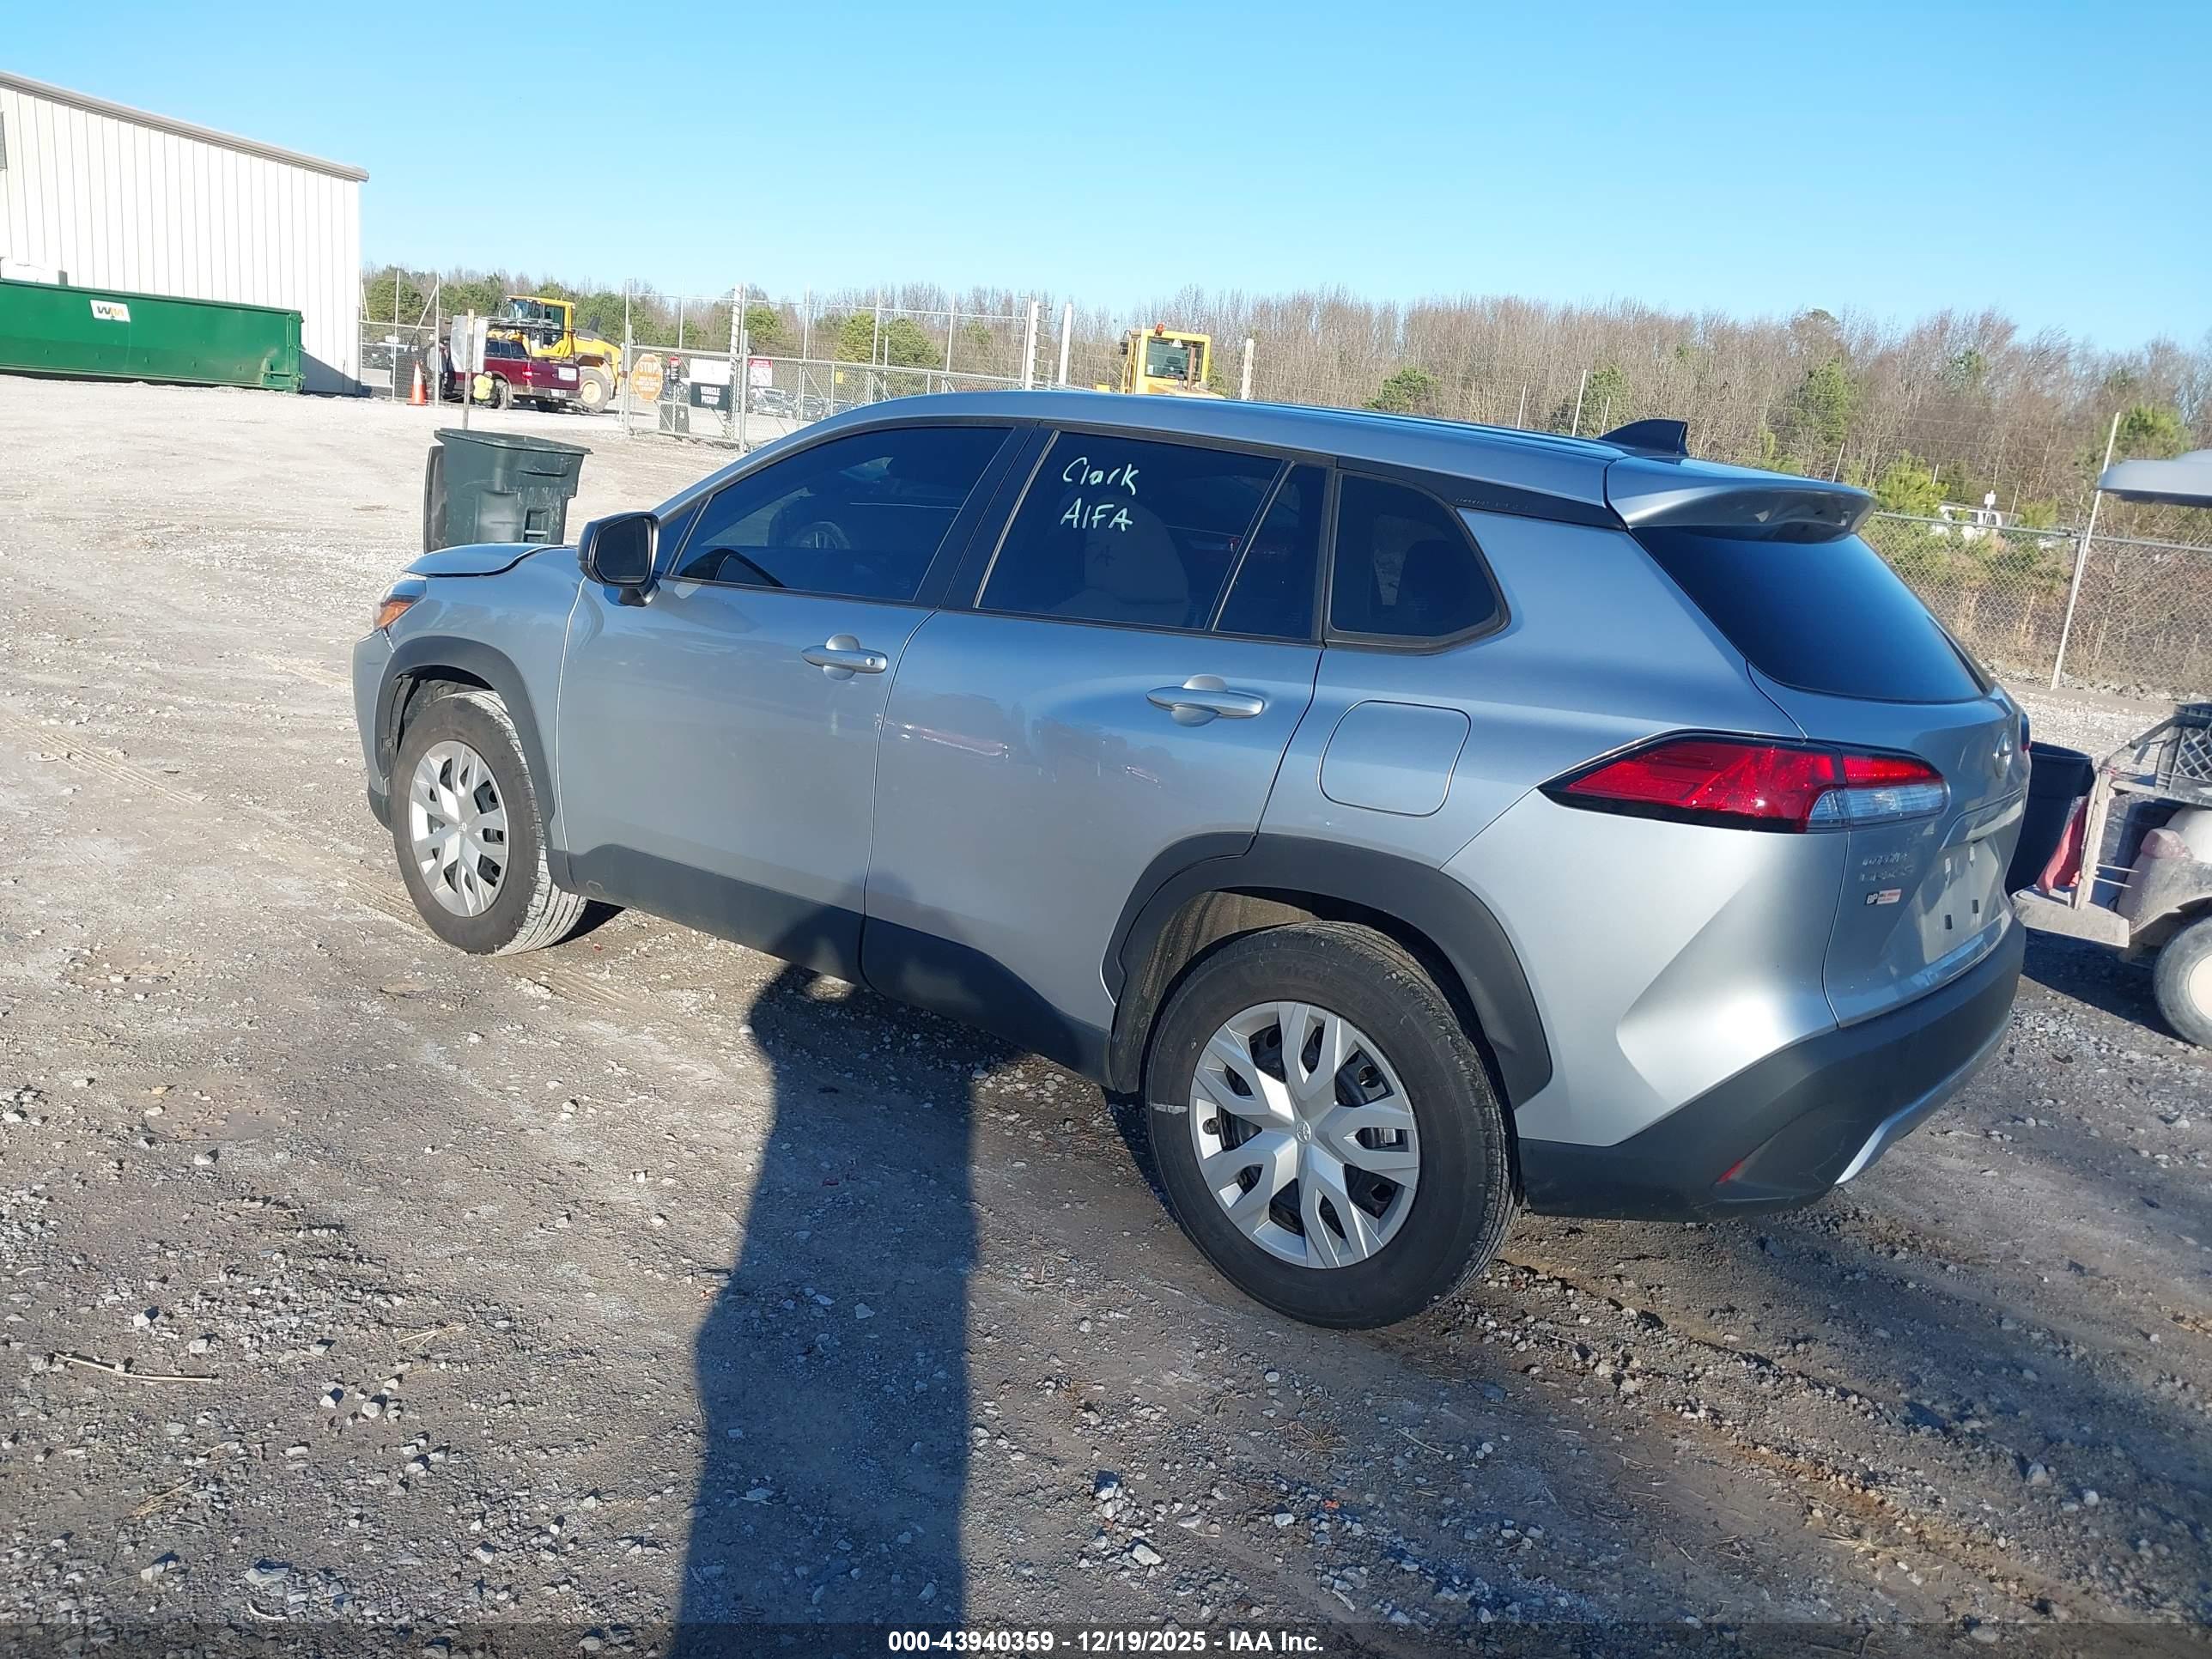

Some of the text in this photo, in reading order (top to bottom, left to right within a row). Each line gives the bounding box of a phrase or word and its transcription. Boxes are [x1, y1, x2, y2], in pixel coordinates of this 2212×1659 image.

[638, 362, 659, 374] STOP
[700, 386, 721, 396] VEHICLE
[701, 395, 720, 405] PICKUP
[1062, 456, 1139, 495] Clark
